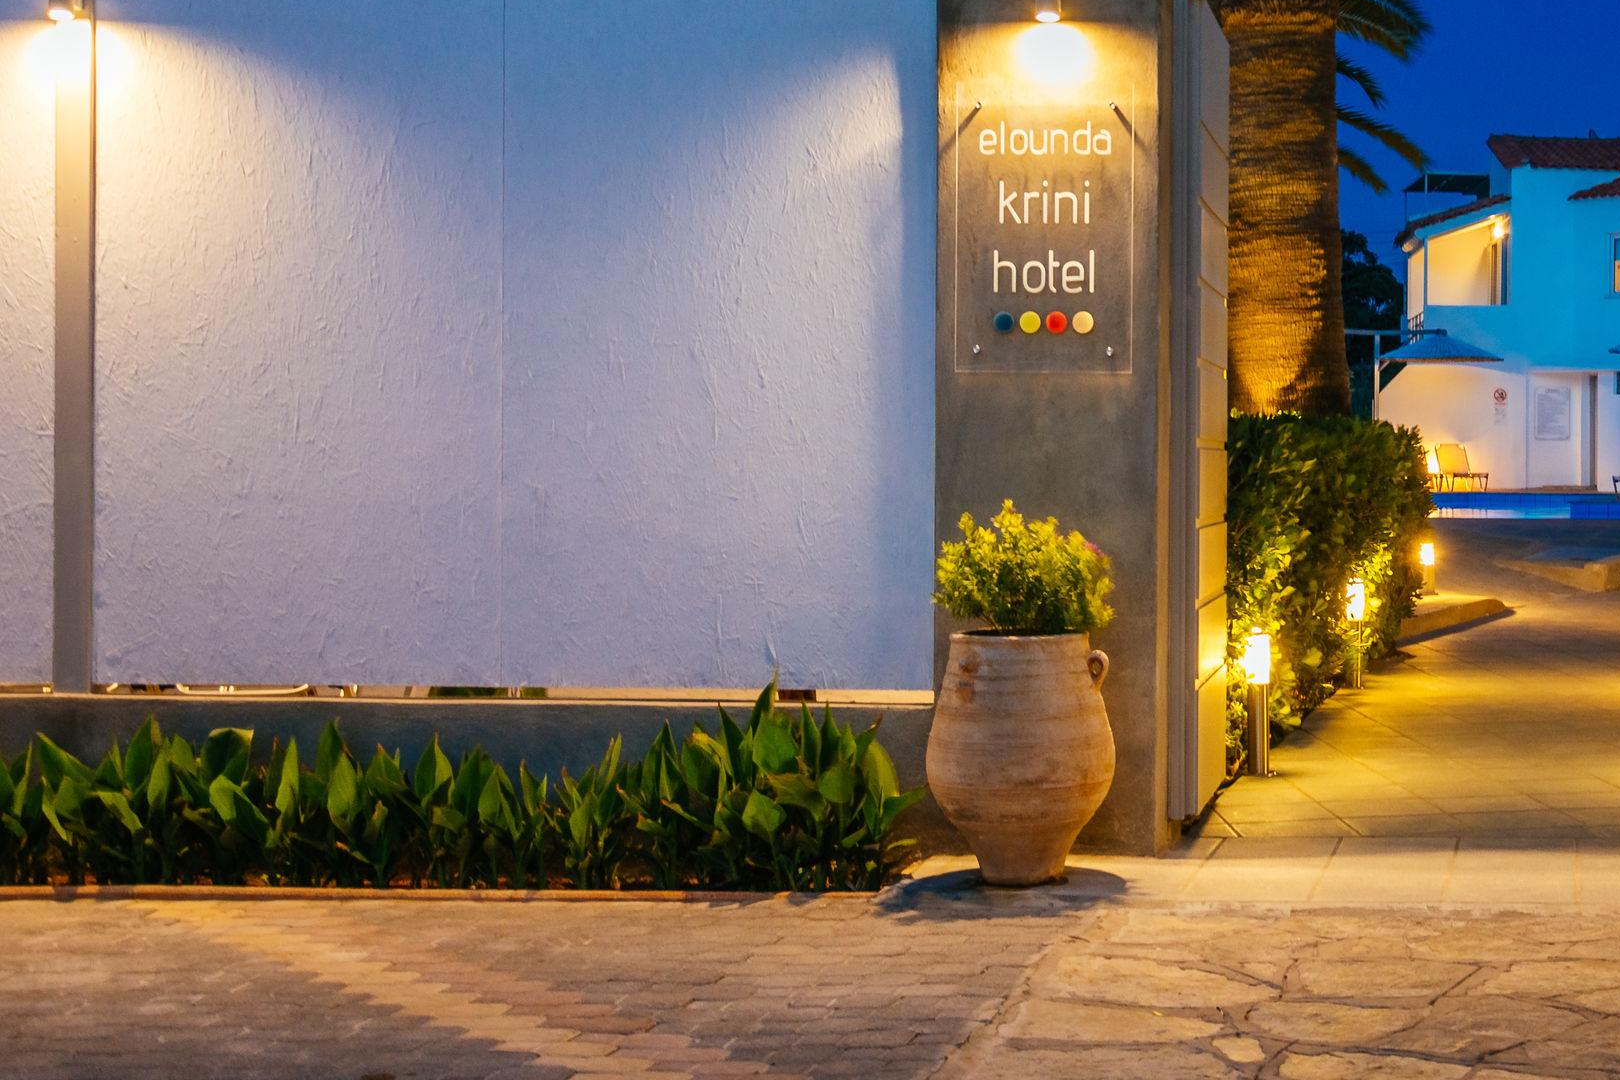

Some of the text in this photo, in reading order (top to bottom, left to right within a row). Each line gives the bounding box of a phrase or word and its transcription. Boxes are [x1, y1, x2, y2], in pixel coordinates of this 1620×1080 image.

[978, 120, 1112, 156] elounda
[998, 180, 1090, 224] krini
[993, 249, 1095, 294] hotel
